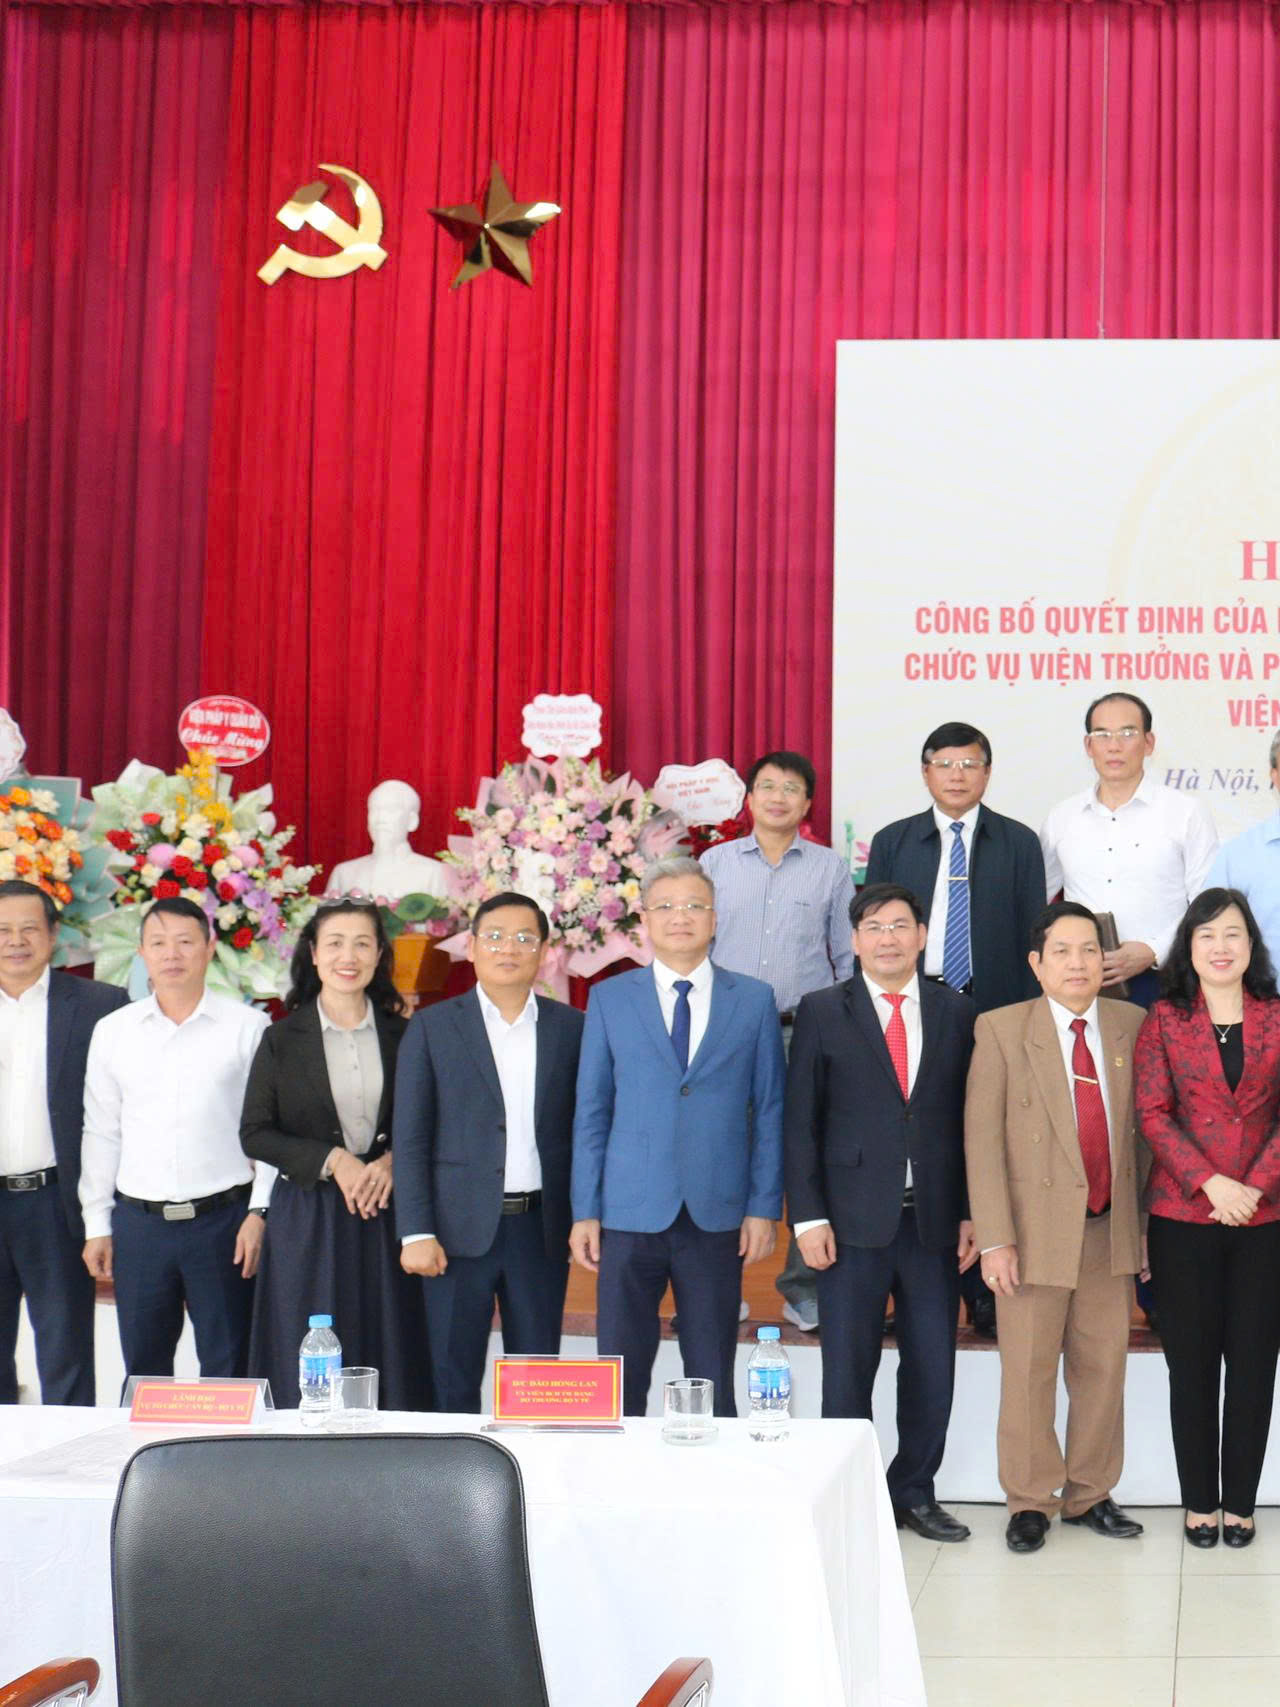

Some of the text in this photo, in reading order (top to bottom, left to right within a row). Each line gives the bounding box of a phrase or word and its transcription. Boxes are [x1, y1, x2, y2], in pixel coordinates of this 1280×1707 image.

[915, 602, 990, 635] CÔNG
[1000, 598, 1036, 635] BỐ
[1045, 598, 1130, 637] QUYẾT
[1137, 606, 1204, 640] ĐỊNH
[1213, 597, 1269, 635] CỦA
[905, 648, 976, 682] CHỨC
[987, 652, 1021, 686] VỤ
[1029, 648, 1092, 686] VIỆN
[1101, 643, 1210, 682] TRƯỞNG
[1219, 649, 1255, 681] VÀ
[1164, 768, 1200, 790] Hà
[1208, 768, 1259, 796] Nội,
